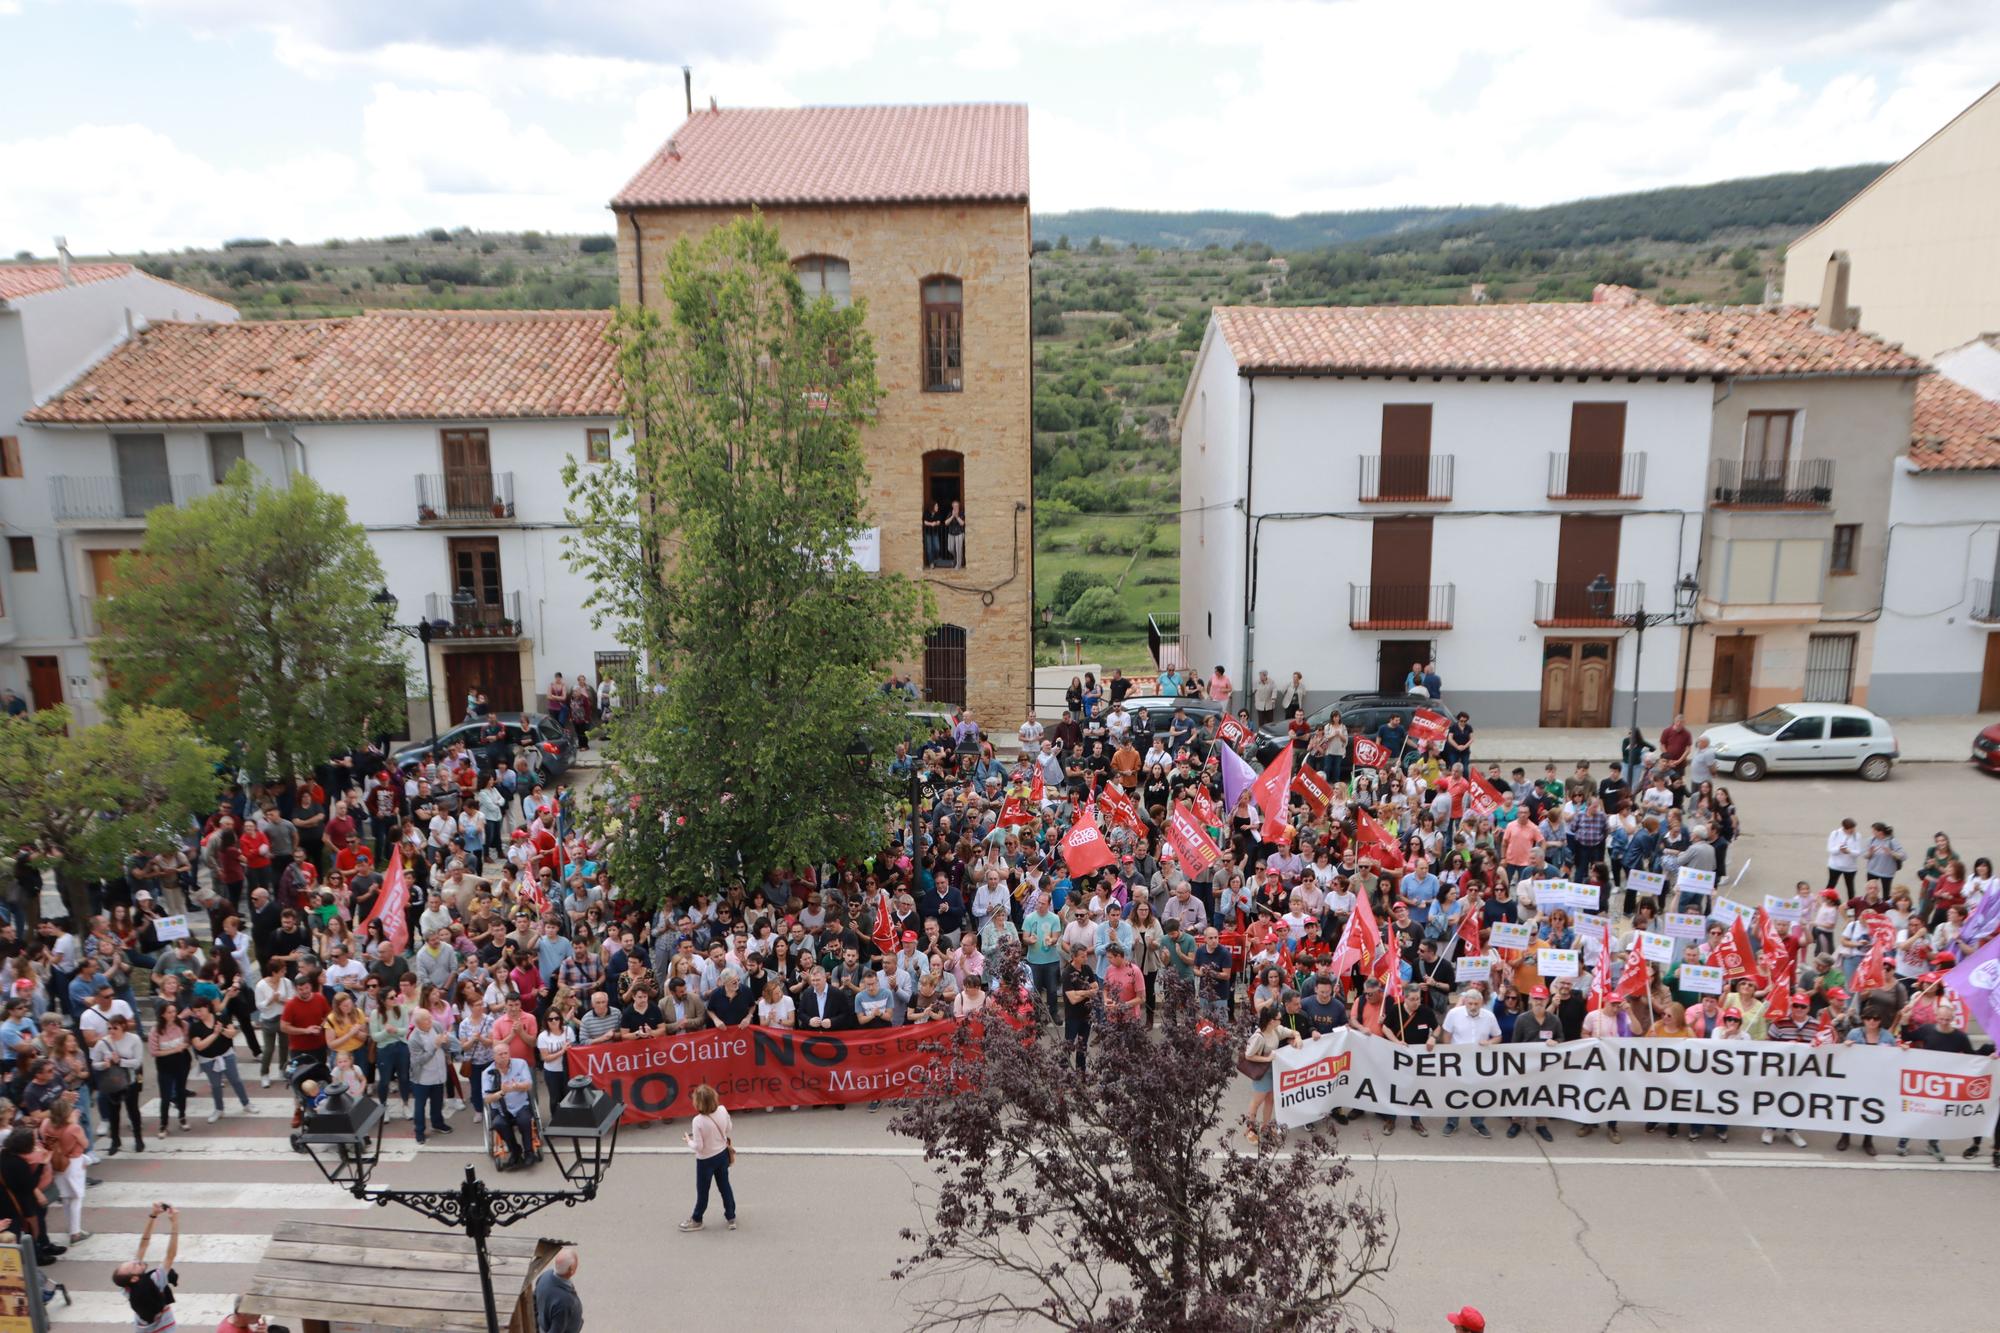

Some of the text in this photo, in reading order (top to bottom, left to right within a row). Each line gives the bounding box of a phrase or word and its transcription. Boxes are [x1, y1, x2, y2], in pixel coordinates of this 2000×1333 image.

[1301, 773, 1322, 798] CCOO
[1174, 809, 1203, 848] CCOO
[588, 1036, 747, 1076] MarieClaire
[753, 1031, 848, 1067] NO
[859, 1043, 886, 1056] es
[1393, 1047, 1846, 1079] PER UN PLA INDUSTRIAL
[717, 1073, 782, 1096] cierre
[790, 1070, 821, 1091] de
[1282, 1062, 1330, 1087] CCOO
[1902, 1072, 1965, 1098] UGT
[1281, 1074, 1349, 1107] industria
[1354, 1078, 1885, 1124] A LA COMARCA DELS PORTS
[1944, 1104, 1985, 1117] FICA
